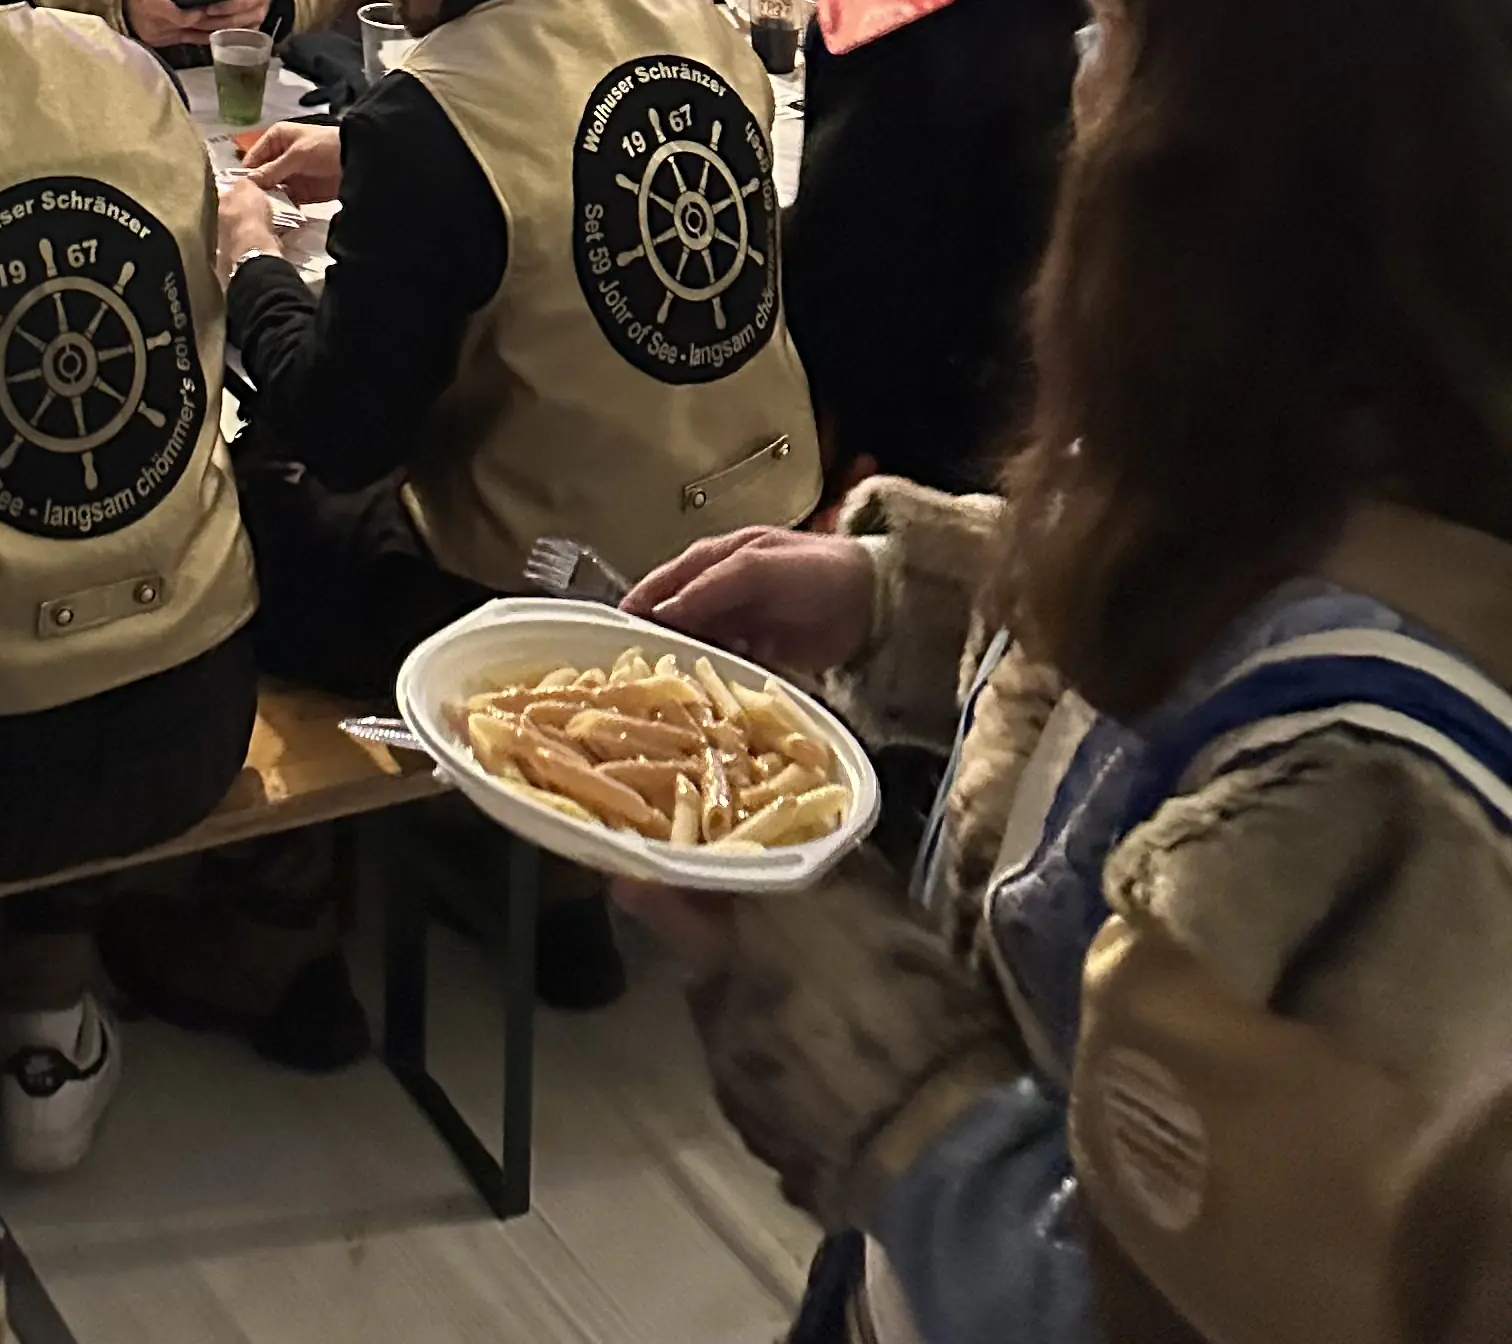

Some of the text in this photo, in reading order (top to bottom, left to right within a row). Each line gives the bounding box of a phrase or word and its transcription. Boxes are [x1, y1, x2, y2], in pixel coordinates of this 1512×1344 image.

[582, 62, 727, 153] Wolhuser Schränzer
[622, 103, 692, 158] 19 67
[41, 190, 151, 239] Schränzer
[584, 203, 604, 243] Set
[67, 238, 98, 268] 67
[589, 246, 612, 275] 59
[599, 279, 633, 324] Johr
[627, 322, 653, 345] of
[647, 331, 678, 364] See
[689, 323, 756, 367] langsam
[42, 487, 136, 532] langsam
